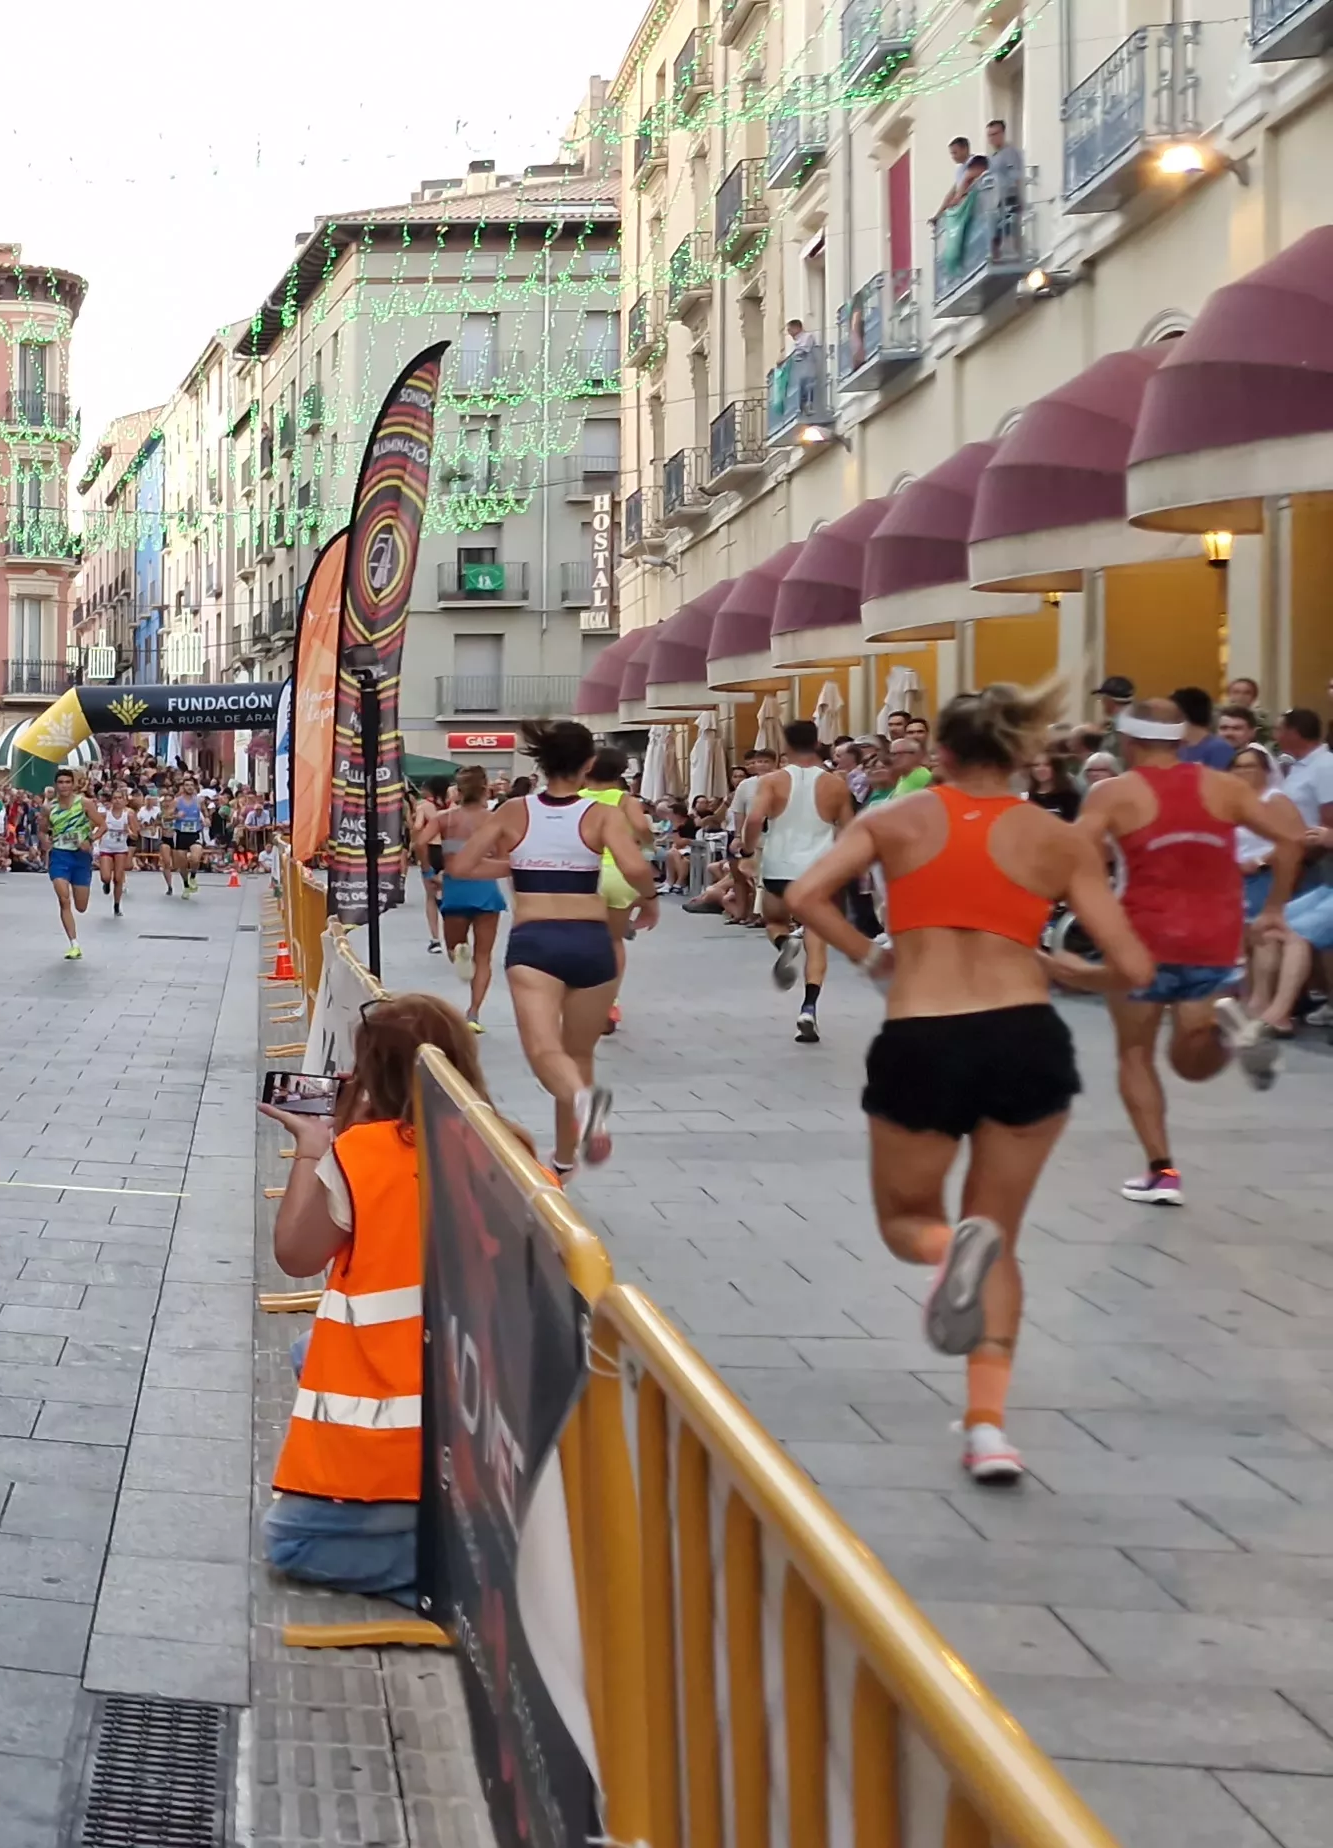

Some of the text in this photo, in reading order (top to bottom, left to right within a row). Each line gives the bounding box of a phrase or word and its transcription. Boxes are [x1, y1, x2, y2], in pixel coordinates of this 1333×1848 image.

[592, 494, 611, 607] HOSTAL
[168, 692, 273, 712] FUNDACIÓN
[142, 716, 174, 726] CAJA
[178, 714, 220, 725] RURAL
[224, 714, 241, 723] DE
[466, 736, 498, 747] GAES
